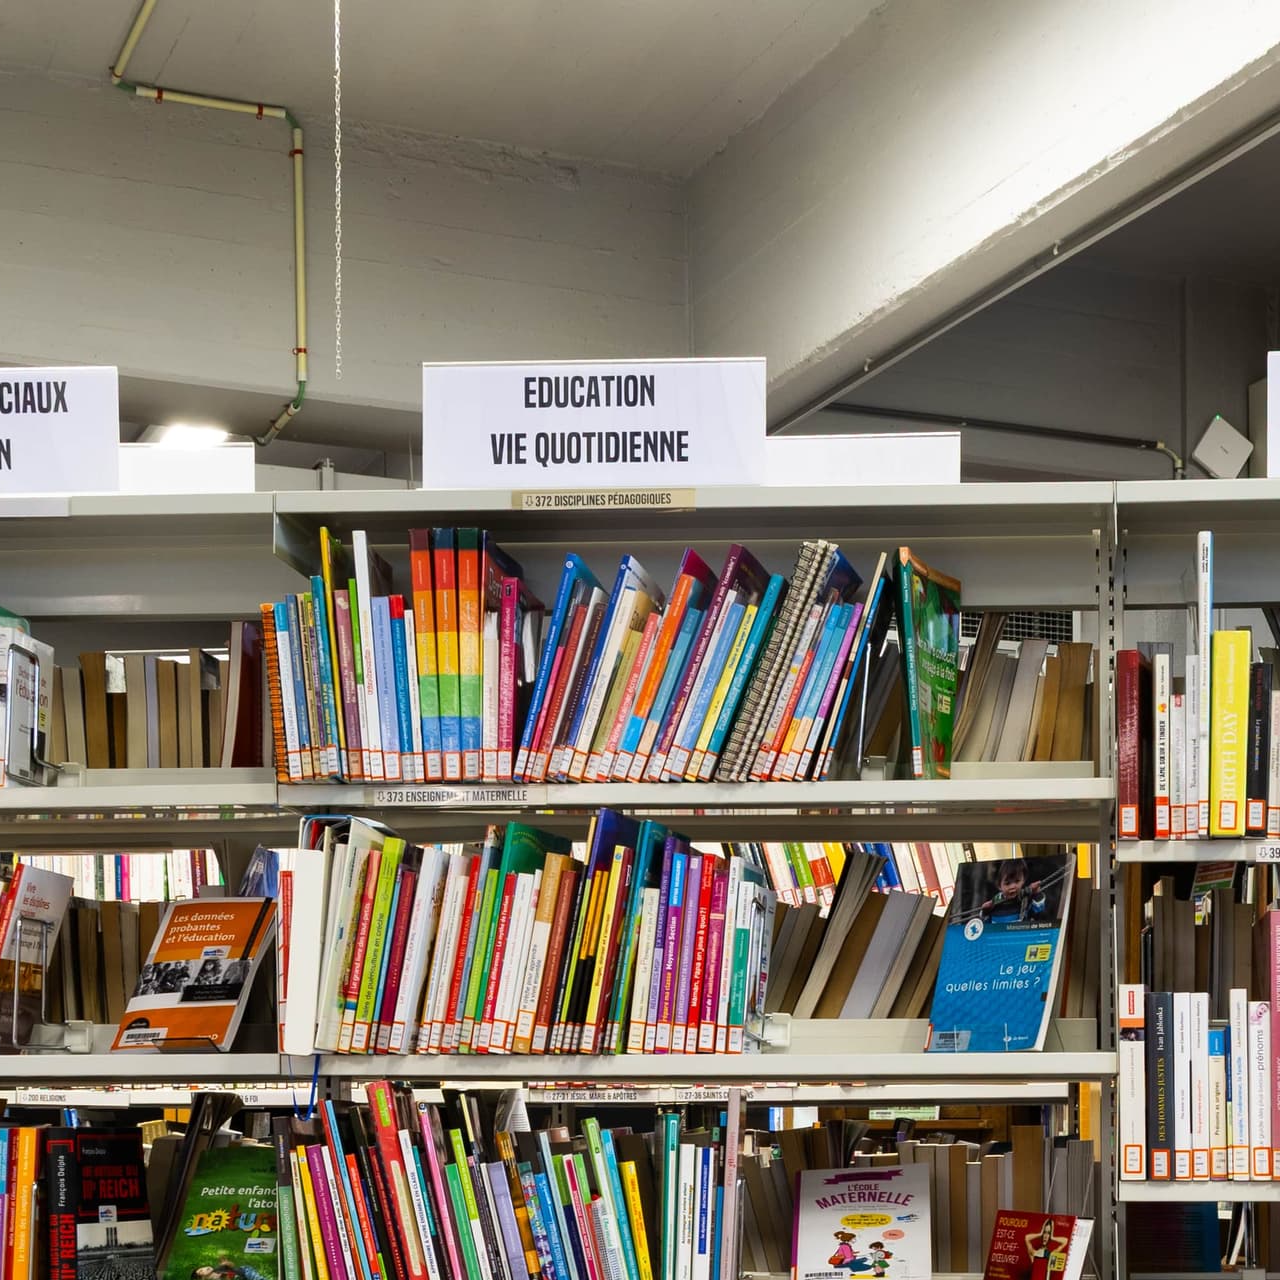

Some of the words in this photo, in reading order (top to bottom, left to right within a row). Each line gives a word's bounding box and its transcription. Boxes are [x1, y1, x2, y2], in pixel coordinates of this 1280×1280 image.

[523, 374, 655, 408] EDUCATION
[490, 433, 527, 465] VIE
[535, 430, 689, 467] QUOTIDIENNE
[535, 496, 553, 507] 372
[554, 494, 606, 506] DISCIPLINES
[607, 492, 672, 506] PÉDAGOGIQUES
[386, 791, 404, 803] 373
[472, 790, 527, 801] MATERNELLE
[174, 912, 190, 923] Les
[190, 911, 235, 922] données
[169, 922, 221, 935] probantes
[165, 935, 176, 944] et
[177, 932, 235, 944] l'éducation
[999, 964, 1013, 976] Le
[1016, 963, 1036, 976] jeu
[945, 977, 989, 994] quelles
[991, 977, 1030, 989] limites
[200, 1186, 236, 1197] Petite
[847, 1182, 880, 1192] L'ÉCOLE
[815, 1190, 915, 1211] MATERNELLE
[59, 1213, 75, 1259] REICH
